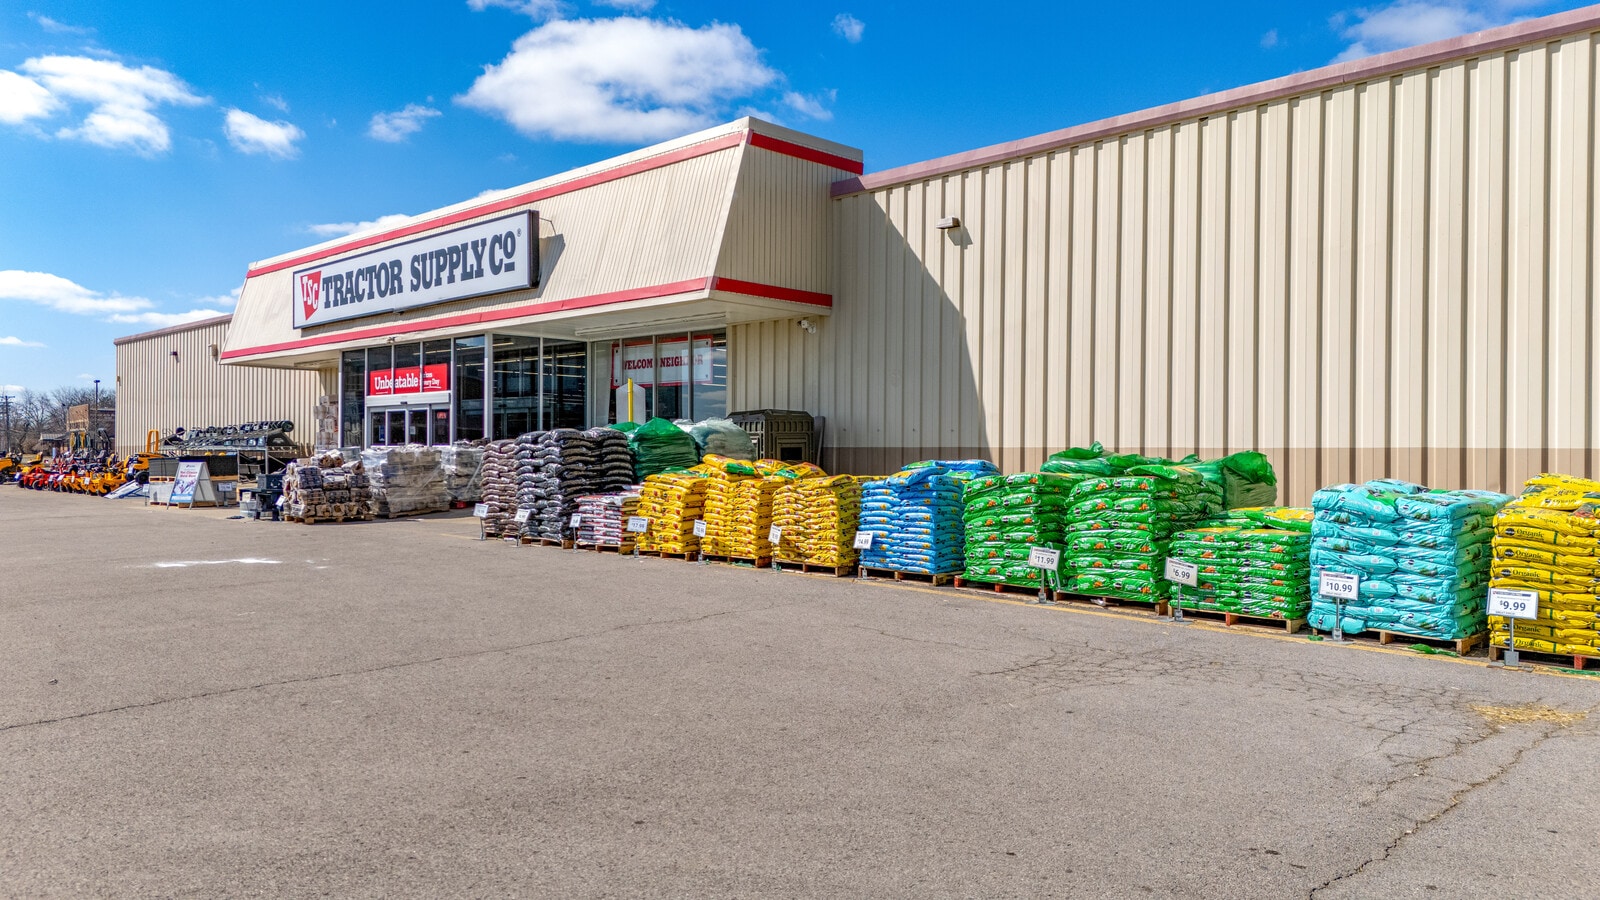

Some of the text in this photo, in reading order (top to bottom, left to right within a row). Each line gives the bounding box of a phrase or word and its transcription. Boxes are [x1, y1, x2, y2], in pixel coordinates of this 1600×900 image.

[322, 259, 403, 309] TRACTOR
[410, 238, 487, 292] SUPPLY
[302, 276, 319, 310] TSC
[374, 373, 419, 390] Unbeatable
[1516, 528, 1544, 537] Organic
[1515, 550, 1543, 559] Organic
[1035, 555, 1054, 565] $11.99
[1173, 568, 1190, 580] $6.99
[1512, 570, 1540, 578] Organic
[1326, 581, 1353, 593] $10.99
[1500, 600, 1526, 611] $9.99
[1513, 624, 1541, 632] Organic
[1515, 639, 1544, 648] Organic
